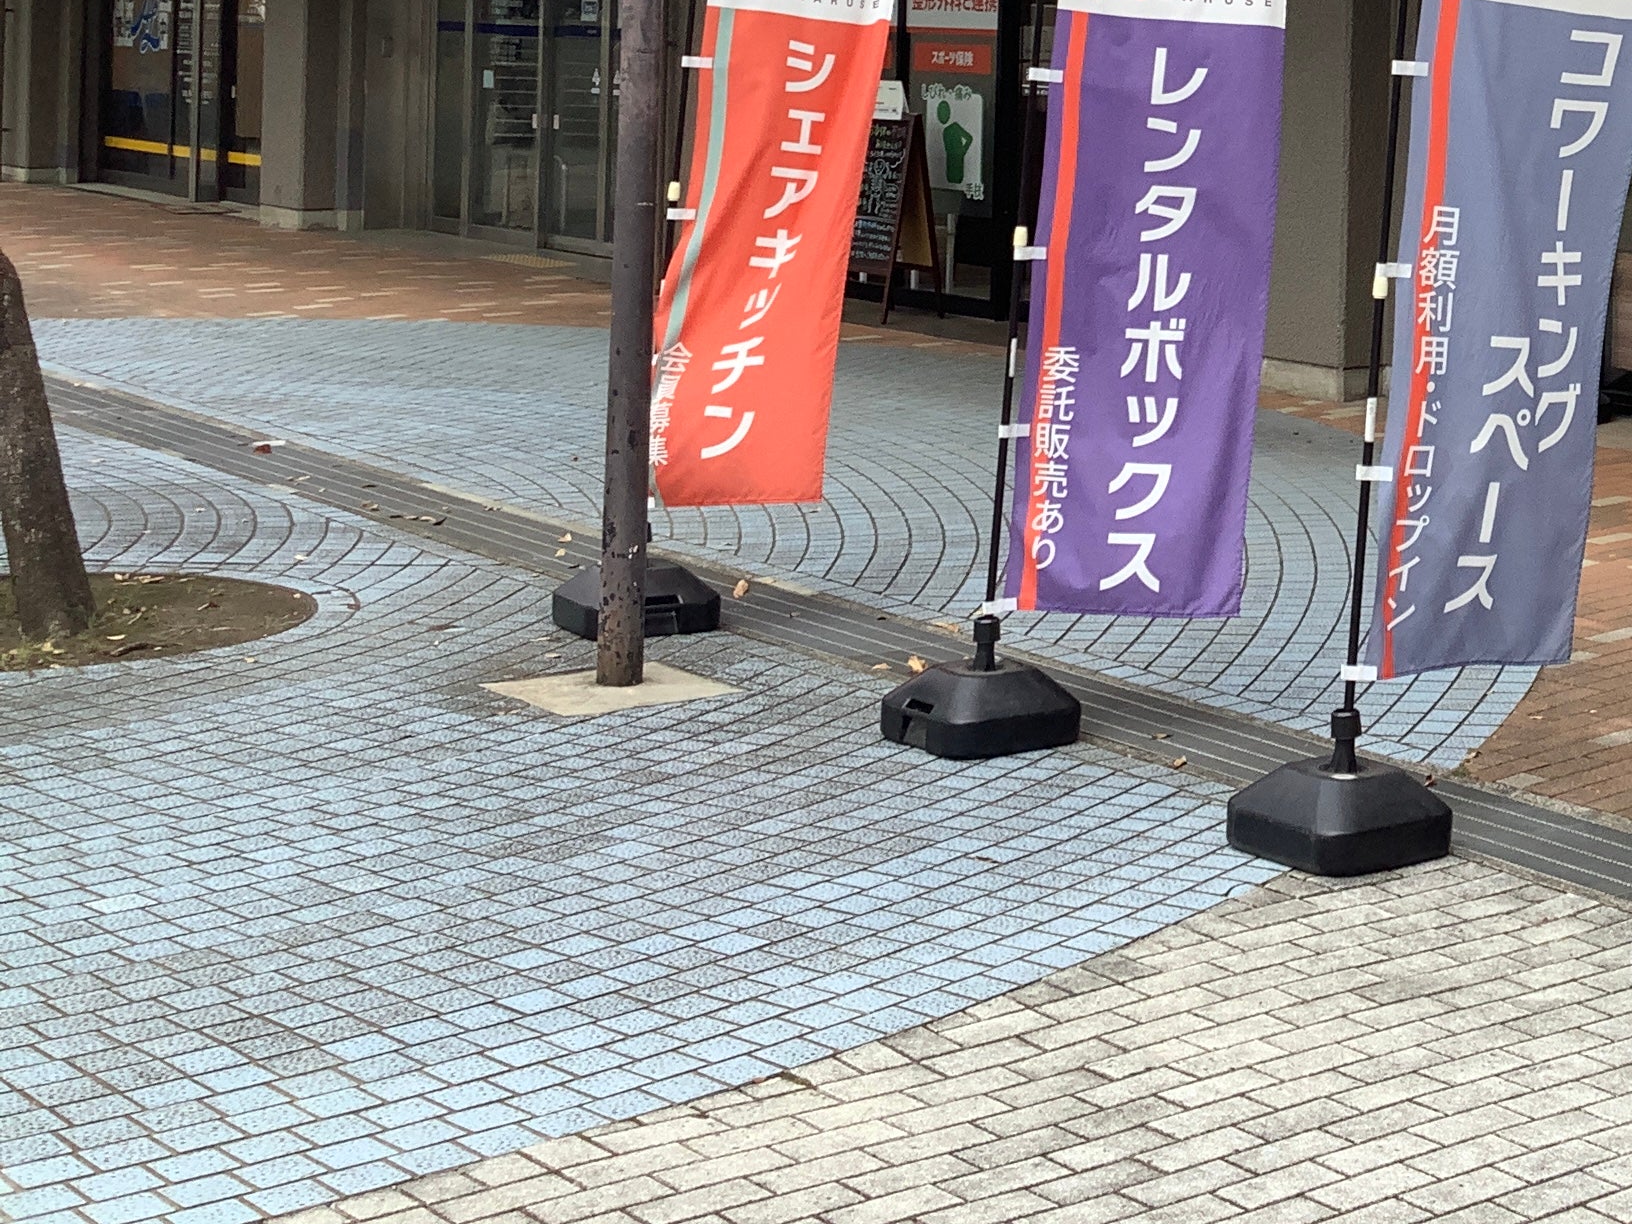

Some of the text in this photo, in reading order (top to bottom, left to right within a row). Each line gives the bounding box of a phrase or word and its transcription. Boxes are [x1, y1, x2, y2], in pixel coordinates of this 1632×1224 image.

[700, 40, 835, 460] シェアキッチン
[1098, 46, 1208, 594] レンタルボックス
[1385, 205, 1461, 633] 月額利用・ドロップイン
[1534, 29, 1624, 454] コワーキング
[1029, 346, 1081, 570] 委託販売あり
[1443, 334, 1534, 614] スペース
